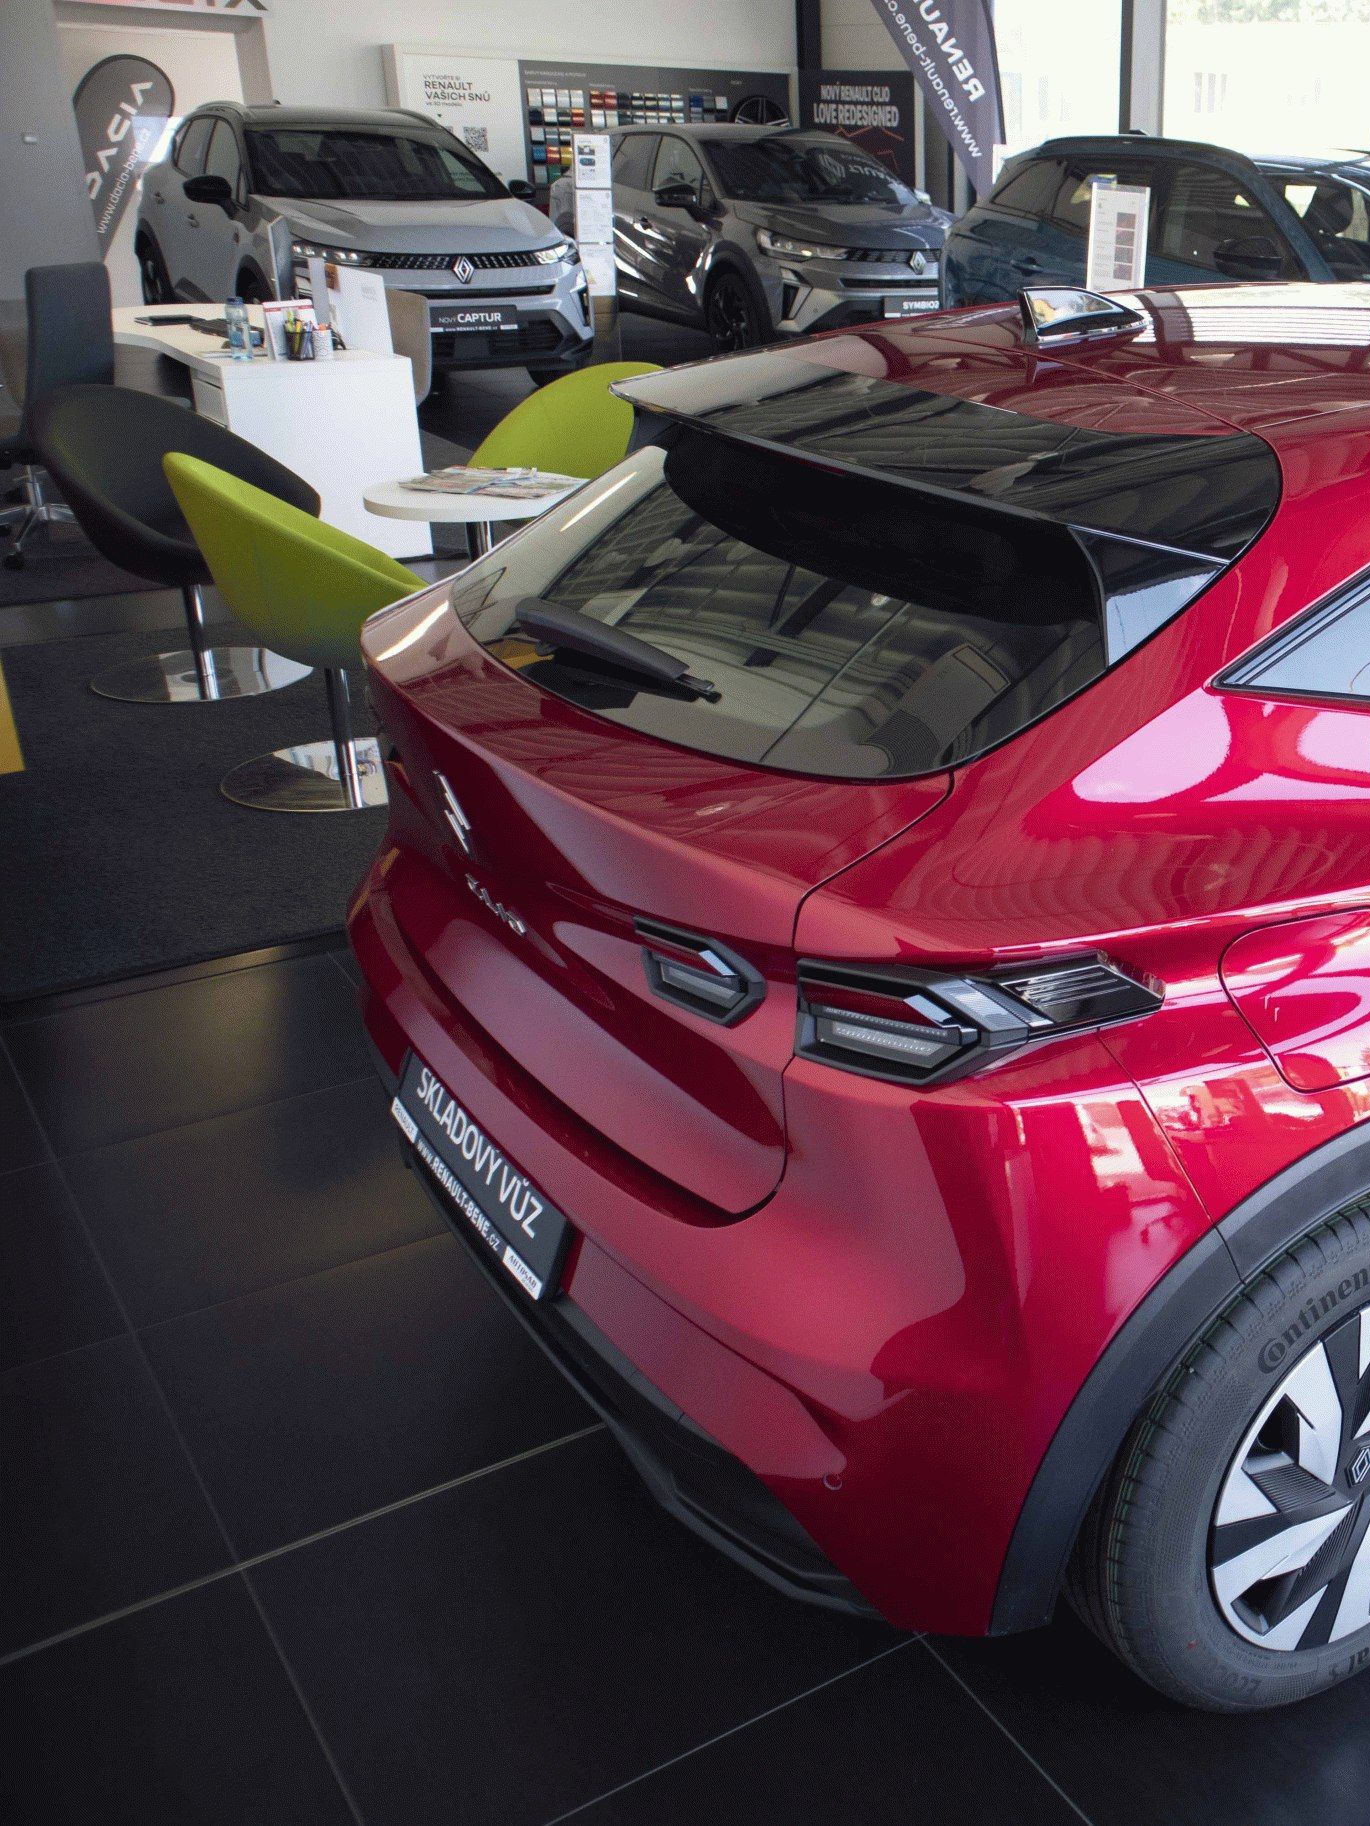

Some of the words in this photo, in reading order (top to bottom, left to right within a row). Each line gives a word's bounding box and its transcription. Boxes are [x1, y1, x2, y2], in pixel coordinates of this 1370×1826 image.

[424, 80, 473, 91] RENAULT
[840, 84, 872, 102] RENAULT
[872, 86, 891, 103] CLIO
[425, 90, 466, 101] VAŠICH
[468, 90, 491, 102] SNŮ
[813, 102, 838, 124] LOVE
[838, 104, 900, 127] REDESIGNED
[85, 81, 154, 200] DACIA
[457, 312, 502, 323] CAPTUR
[416, 1066, 503, 1187] SKLADOVÝ
[499, 1164, 544, 1240] VŮZ
